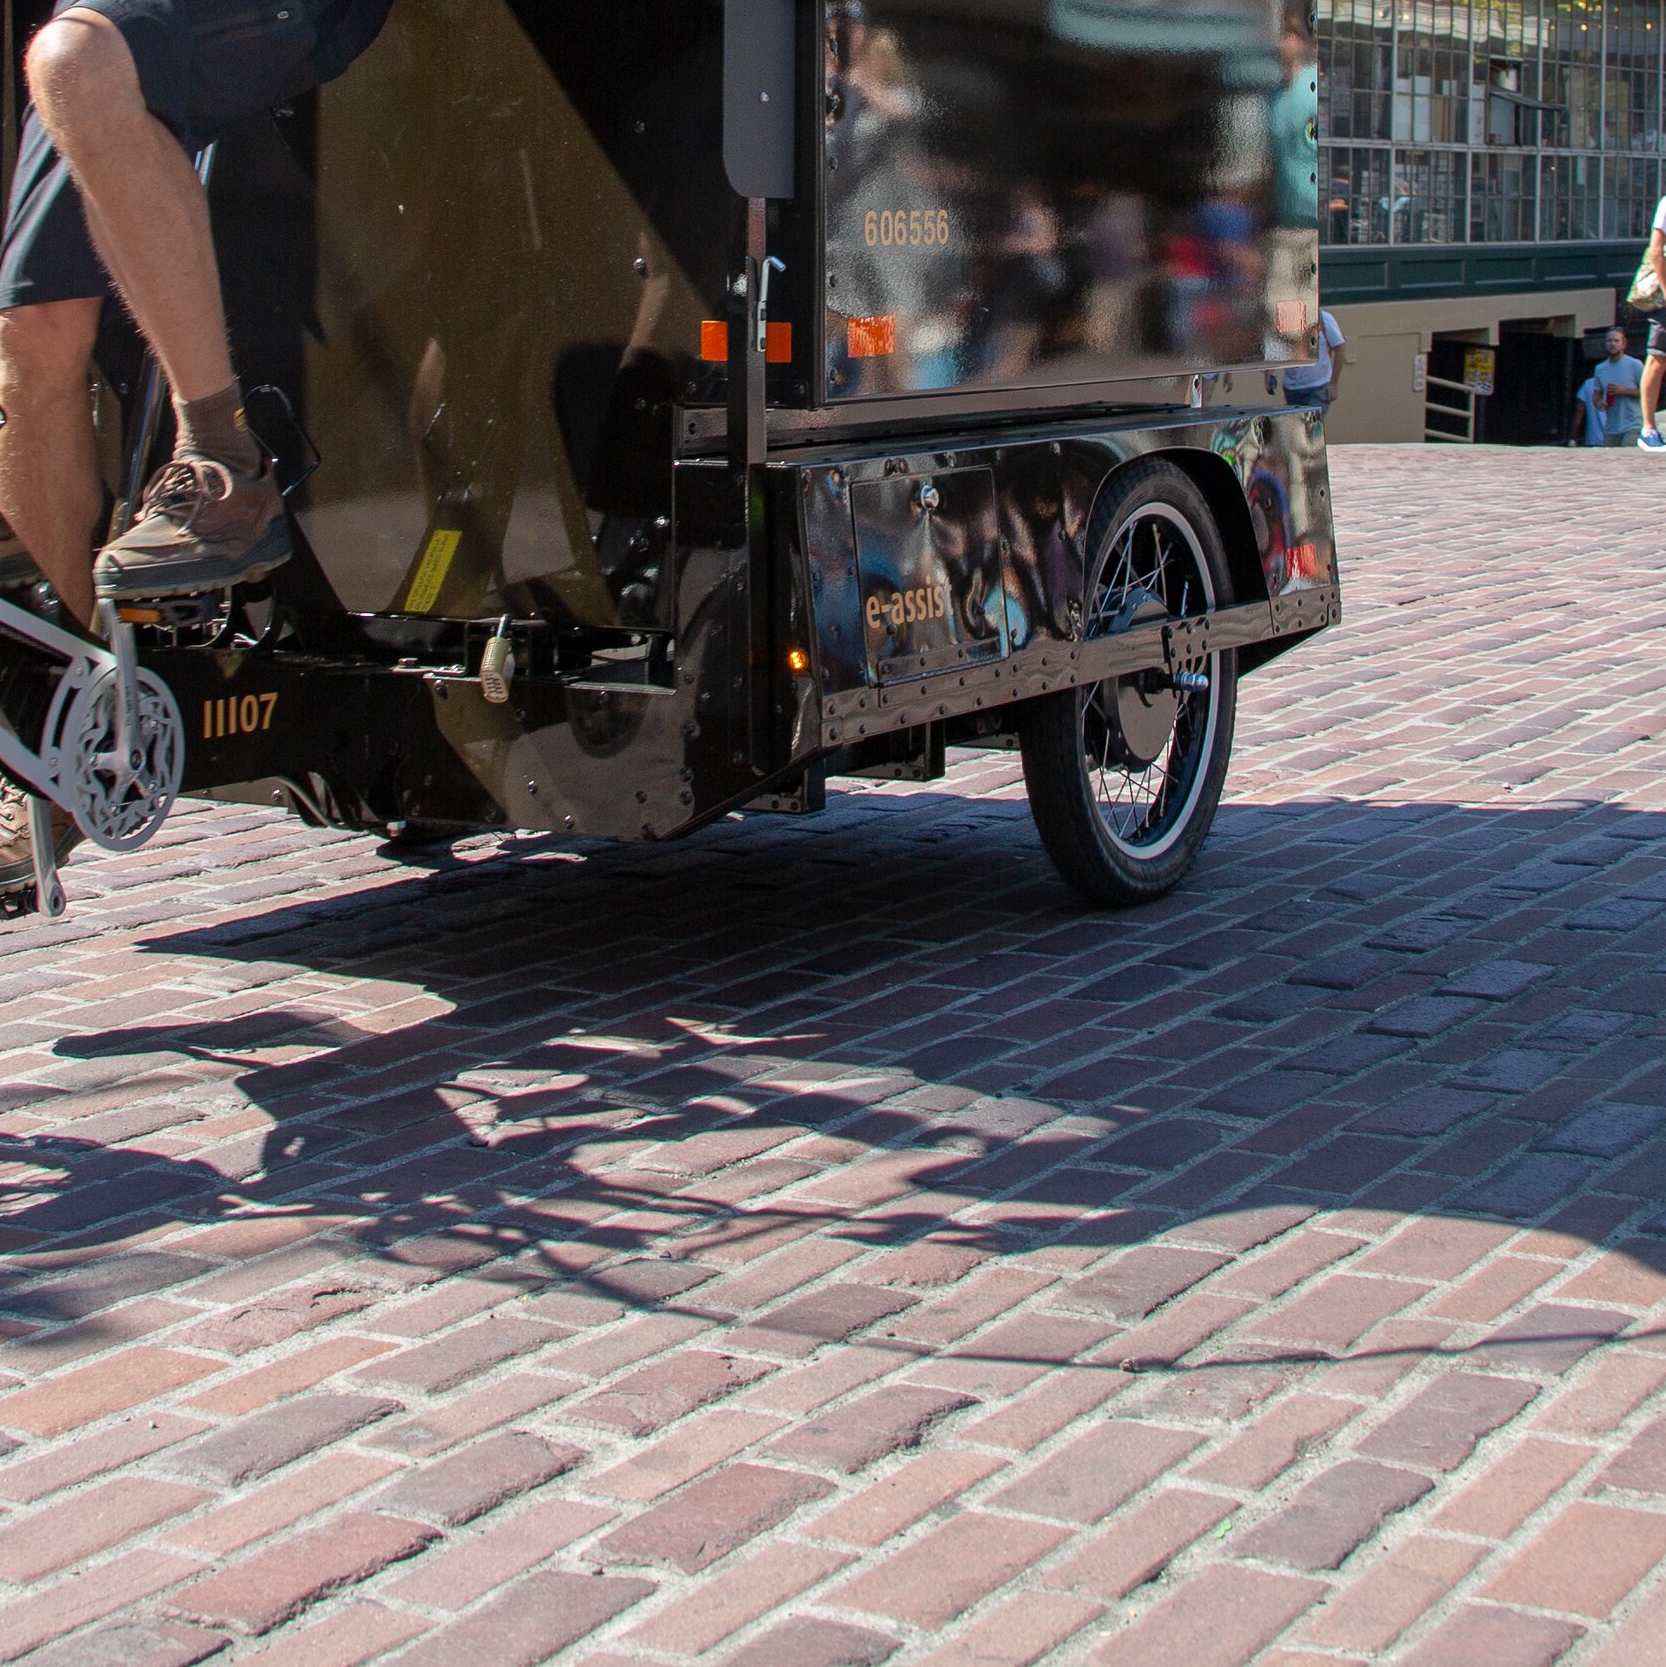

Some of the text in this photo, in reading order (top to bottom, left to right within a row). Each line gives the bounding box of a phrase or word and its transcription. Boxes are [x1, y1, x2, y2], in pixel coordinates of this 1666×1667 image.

[864, 209, 950, 247] 606556
[866, 575, 954, 629] e-assist
[204, 692, 278, 738] 11107
